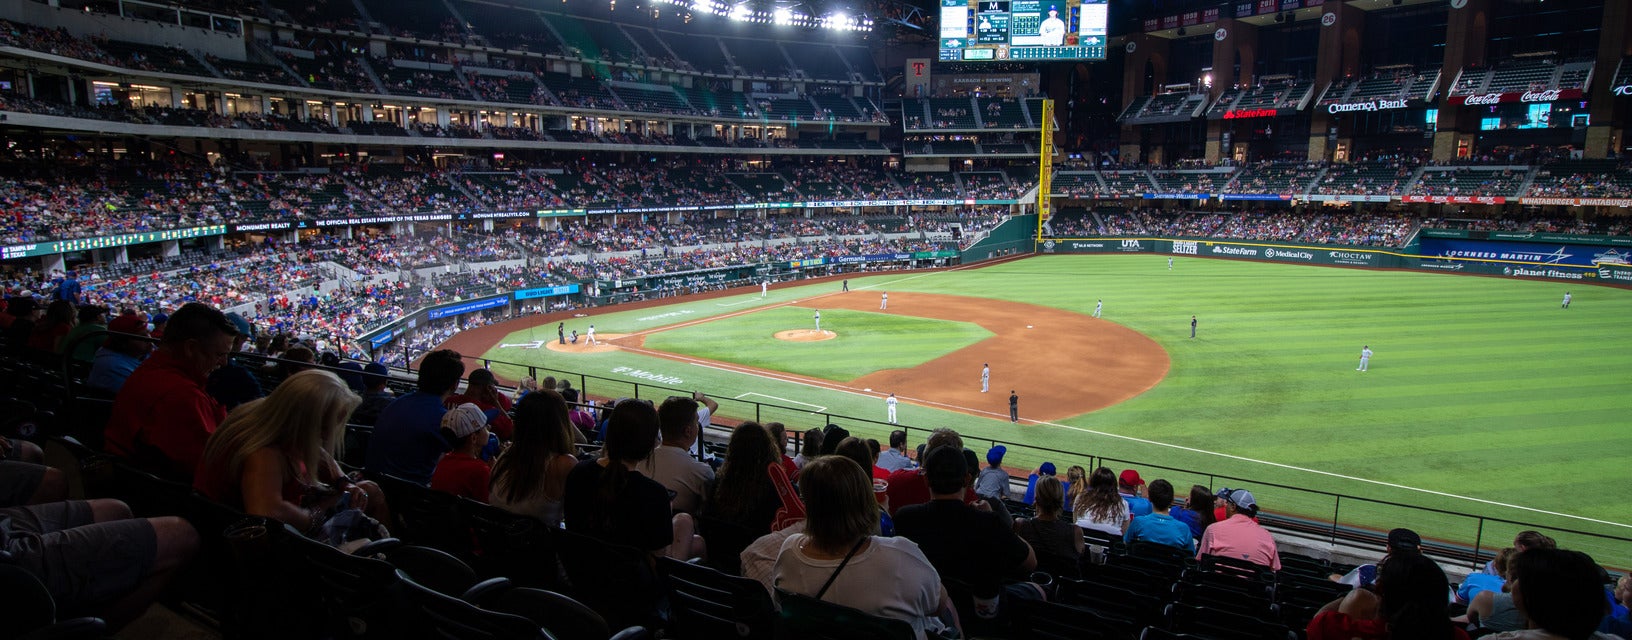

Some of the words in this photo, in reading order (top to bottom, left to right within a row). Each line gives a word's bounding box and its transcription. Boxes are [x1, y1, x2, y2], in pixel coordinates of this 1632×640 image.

[1324, 15, 1334, 24] 26
[1216, 30, 1226, 39] 34
[912, 62, 924, 75] T
[1378, 100, 1408, 110] Bank
[1172, 245, 1198, 254] SELTZER
[1445, 250, 1497, 258] LOCKHEED
[1300, 252, 1313, 260] City
[1513, 267, 1546, 278] planet
[1547, 269, 1583, 279] fitness
[623, 370, 684, 384] Mobile
